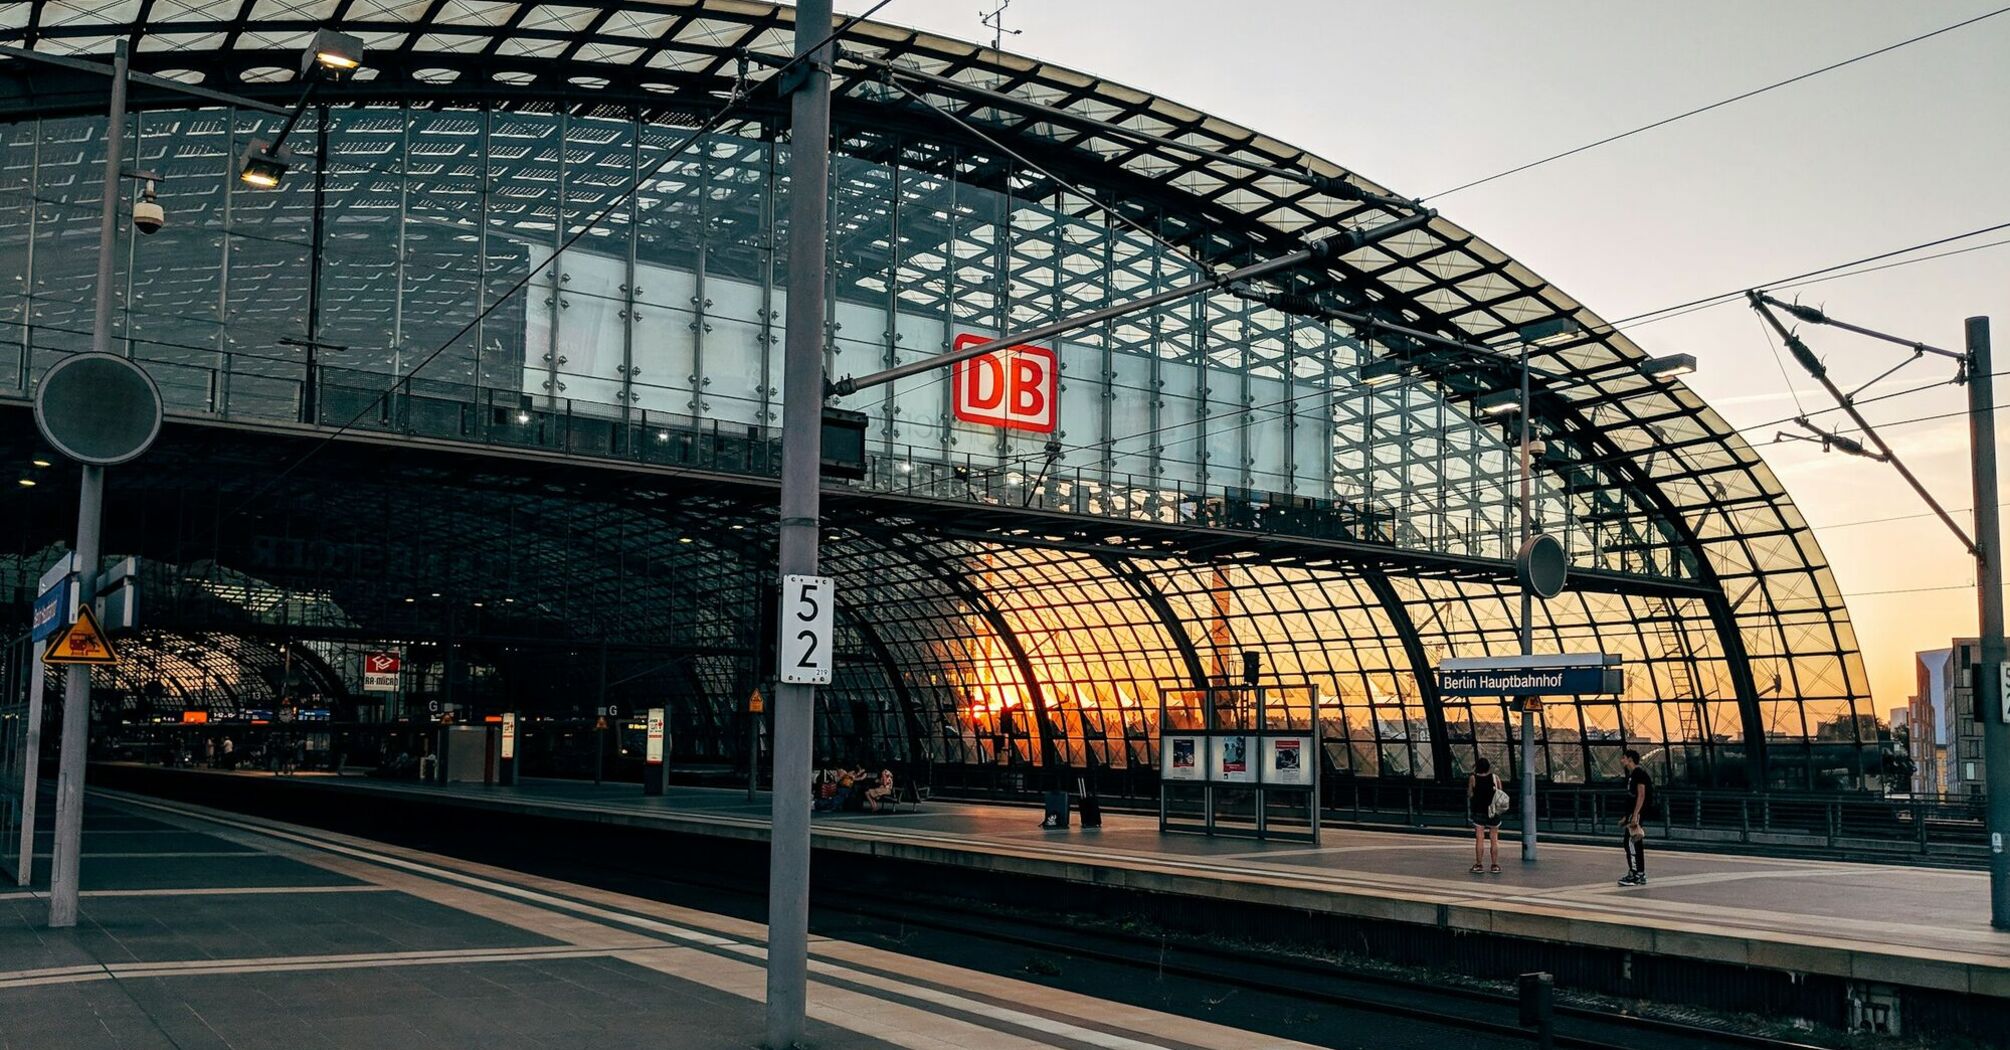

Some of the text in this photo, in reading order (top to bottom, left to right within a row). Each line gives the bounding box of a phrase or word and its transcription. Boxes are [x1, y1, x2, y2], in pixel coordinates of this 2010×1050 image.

[967, 353, 1045, 417] DB
[796, 584, 819, 622] 5
[796, 629, 818, 668] 2
[1444, 672, 1563, 691] Berlin Hauptbahnhof
[429, 699, 438, 711] G
[608, 705, 618, 716] G
